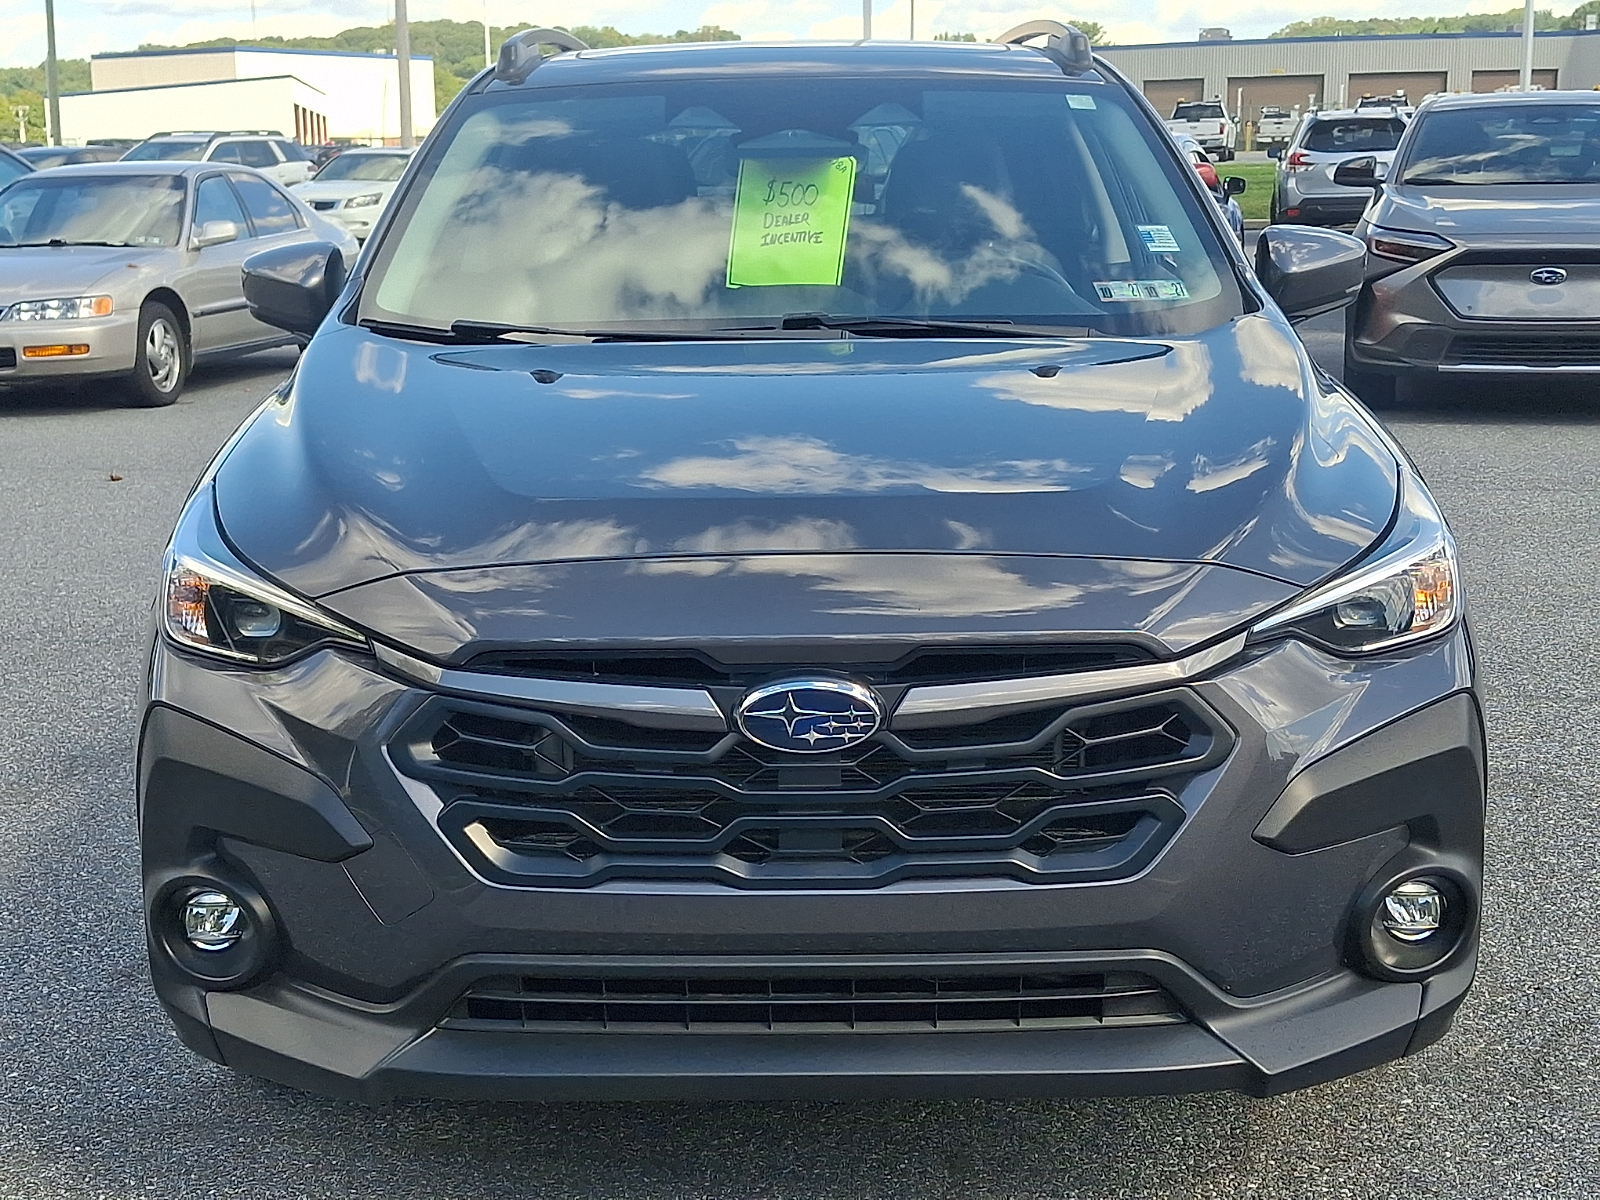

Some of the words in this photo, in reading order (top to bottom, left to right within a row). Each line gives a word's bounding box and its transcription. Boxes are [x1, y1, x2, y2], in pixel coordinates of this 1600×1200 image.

[762, 177, 819, 207] $500
[763, 212, 810, 229] DEALER
[760, 230, 824, 247] INCENTIVE
[1099, 286, 1114, 298] 10
[1127, 283, 1142, 297] 27
[1144, 286, 1160, 298] 10
[1171, 282, 1186, 297] 27
